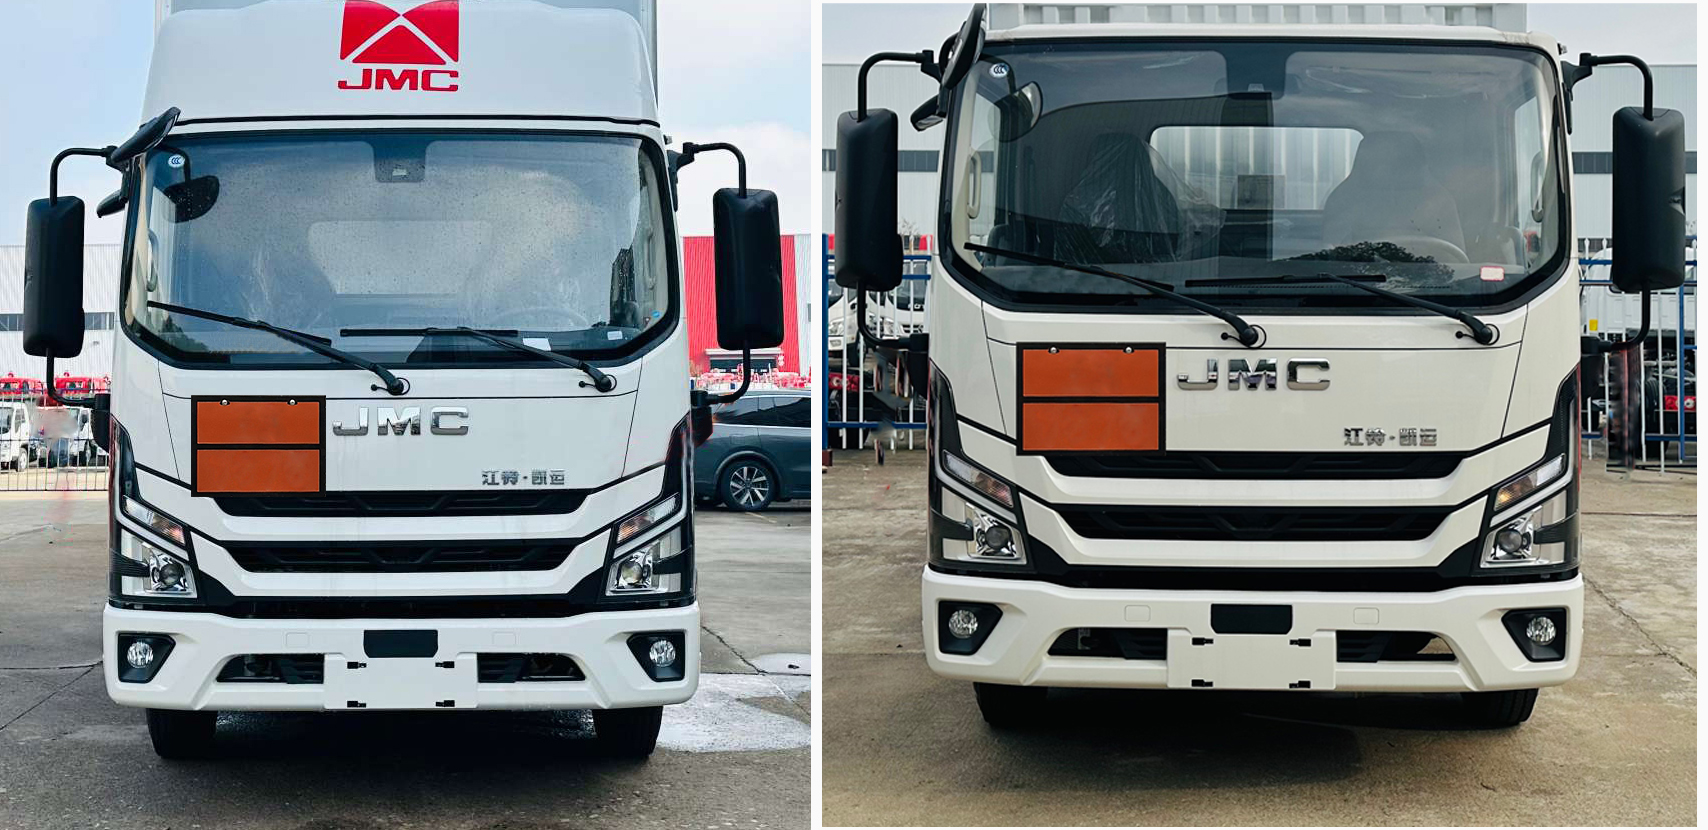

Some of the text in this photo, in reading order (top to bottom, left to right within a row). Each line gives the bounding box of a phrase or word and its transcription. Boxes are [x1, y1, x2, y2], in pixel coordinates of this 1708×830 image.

[338, 68, 459, 92] JMC
[1177, 357, 1331, 391] JMC
[332, 406, 469, 436] JMC
